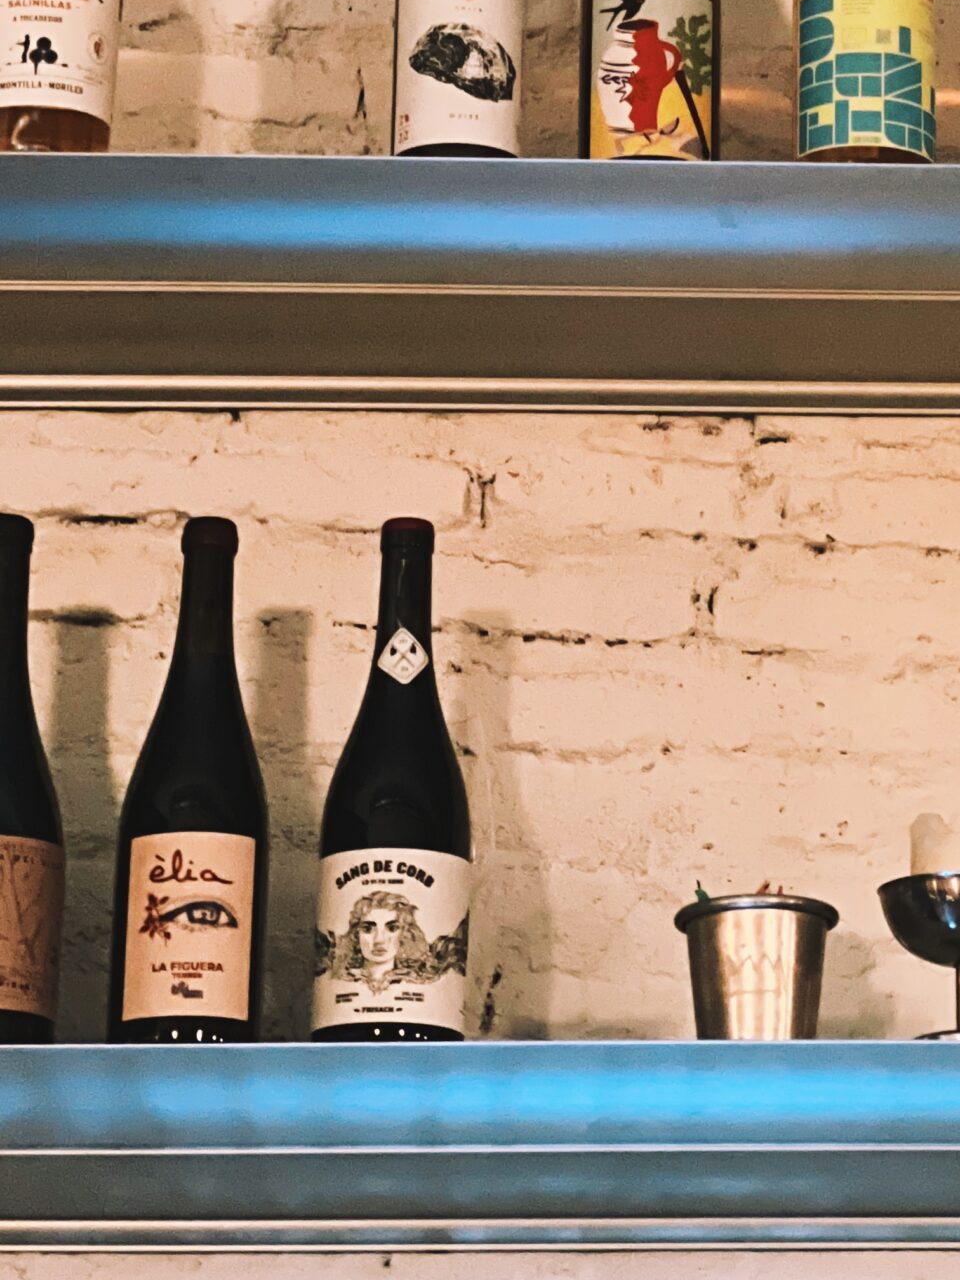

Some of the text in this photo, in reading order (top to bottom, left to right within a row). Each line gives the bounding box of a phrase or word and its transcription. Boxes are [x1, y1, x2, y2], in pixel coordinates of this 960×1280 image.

[8, 0, 72, 10] SALINILLAS
[335, 862, 370, 890] SANG
[374, 859, 393, 873] DE
[151, 961, 224, 973] LA FIGUERA
